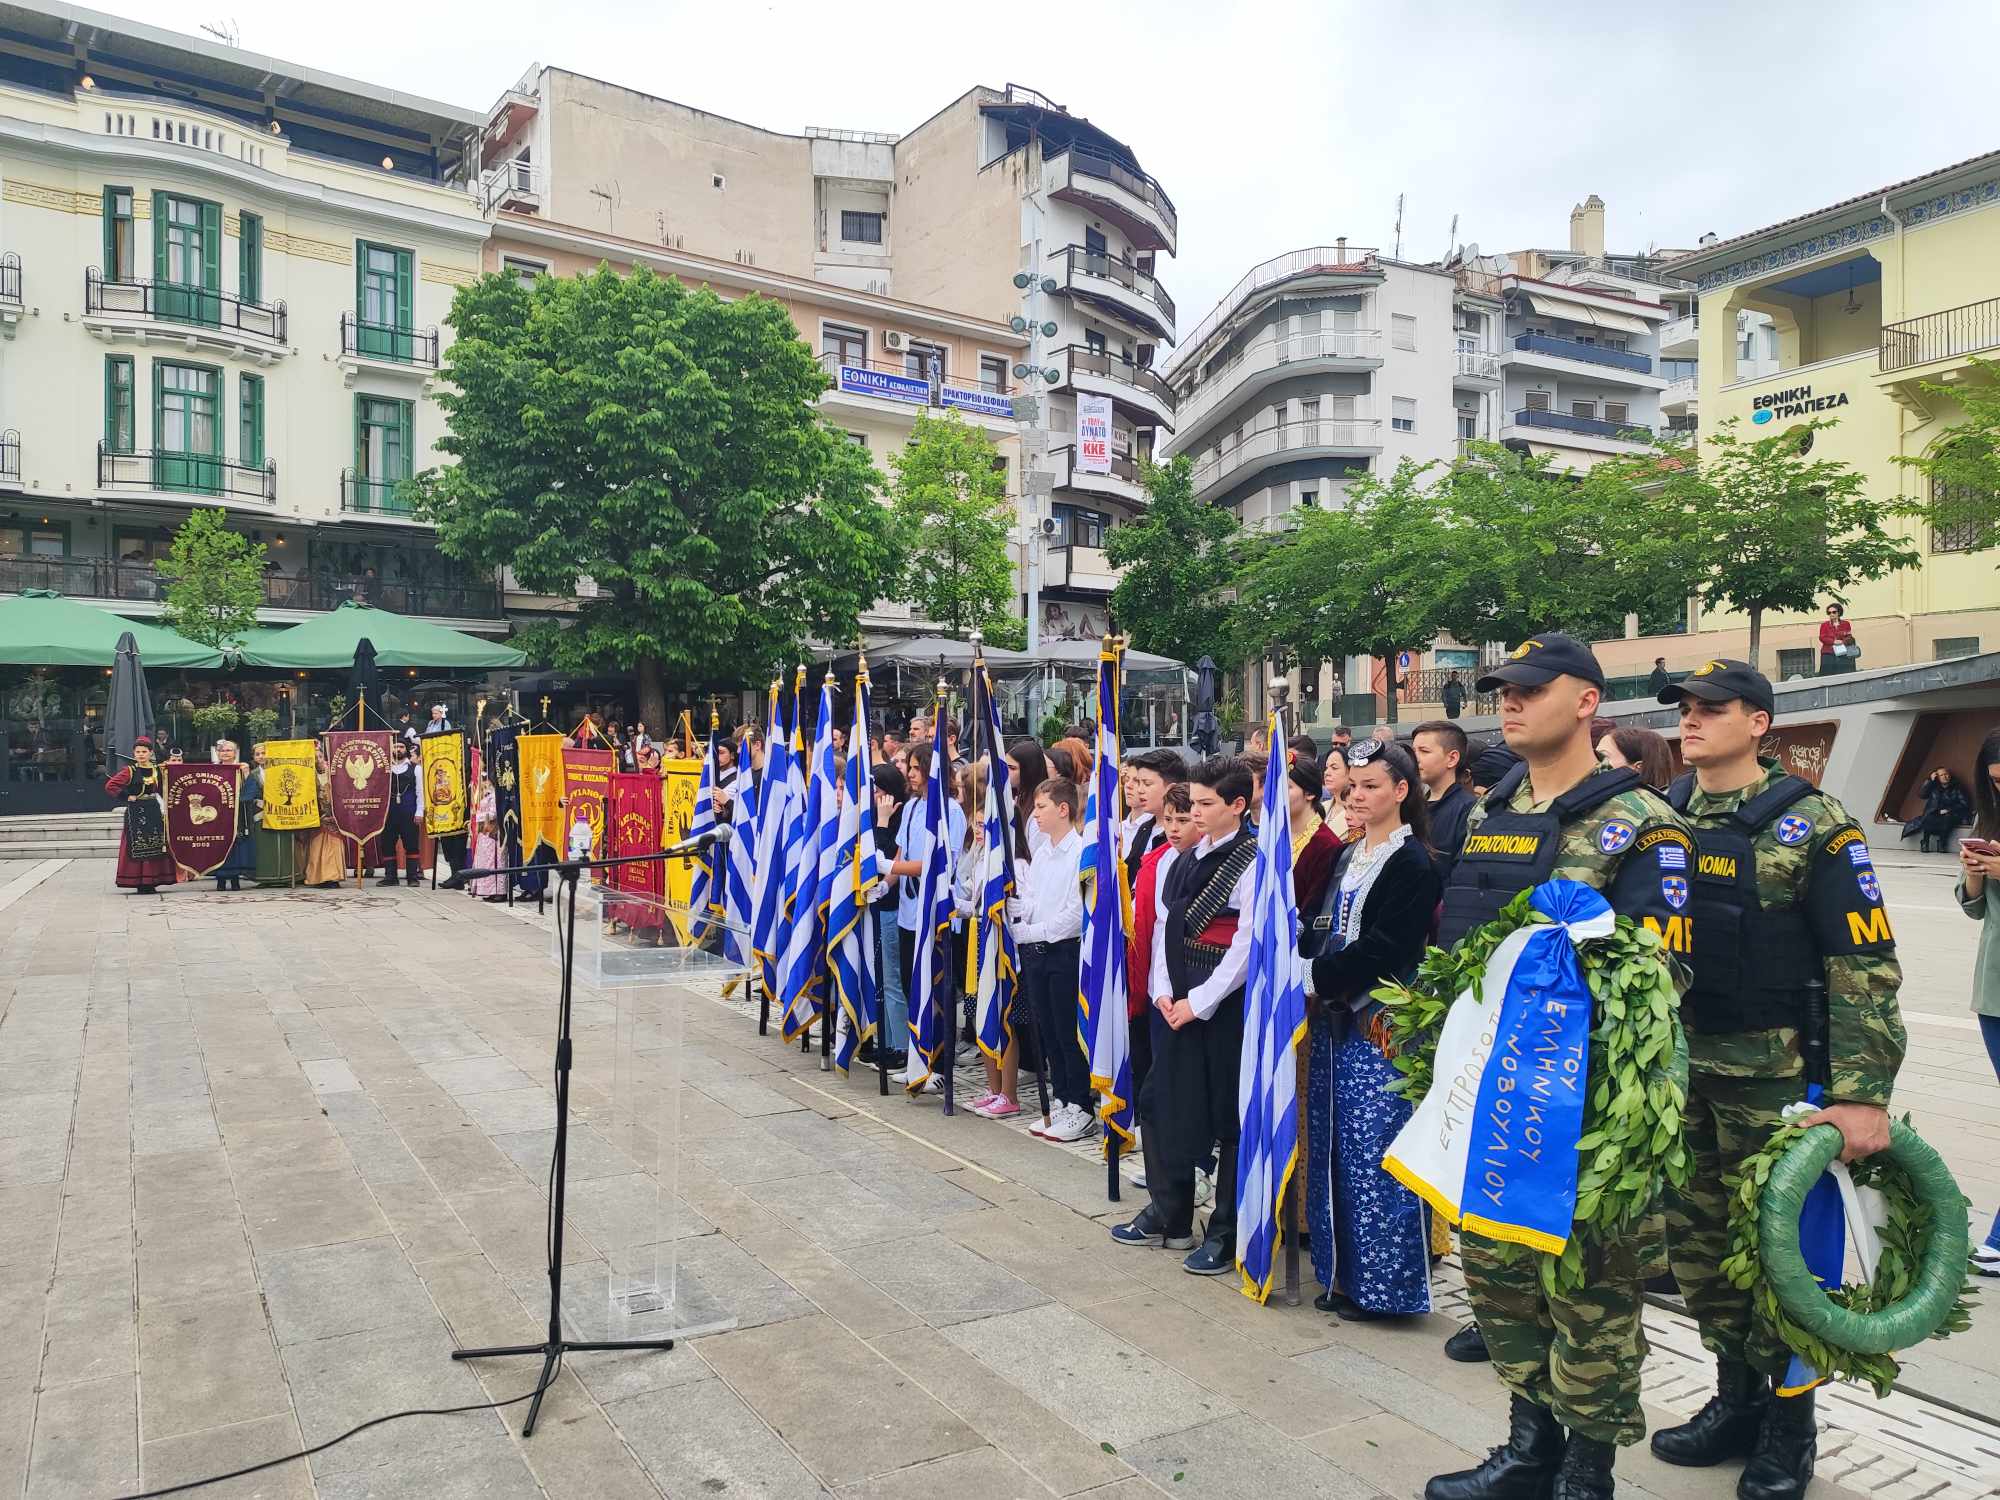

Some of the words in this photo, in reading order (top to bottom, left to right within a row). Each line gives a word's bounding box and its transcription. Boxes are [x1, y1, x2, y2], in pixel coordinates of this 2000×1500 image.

[1753, 385, 1811, 410] ΕΘΝΙΚΗ
[1774, 392, 1849, 420] ΤΡΑΠΕΖΑ
[1083, 442, 1106, 455] ΚΚΕ
[1465, 835, 1539, 855] ΣΤΡΑΤΟΝΟΜΙΑ
[1559, 1041, 1584, 1092] ΤΟΥ
[1518, 1000, 1568, 1164] ΕΛΛΗΝΙΚΟΥ
